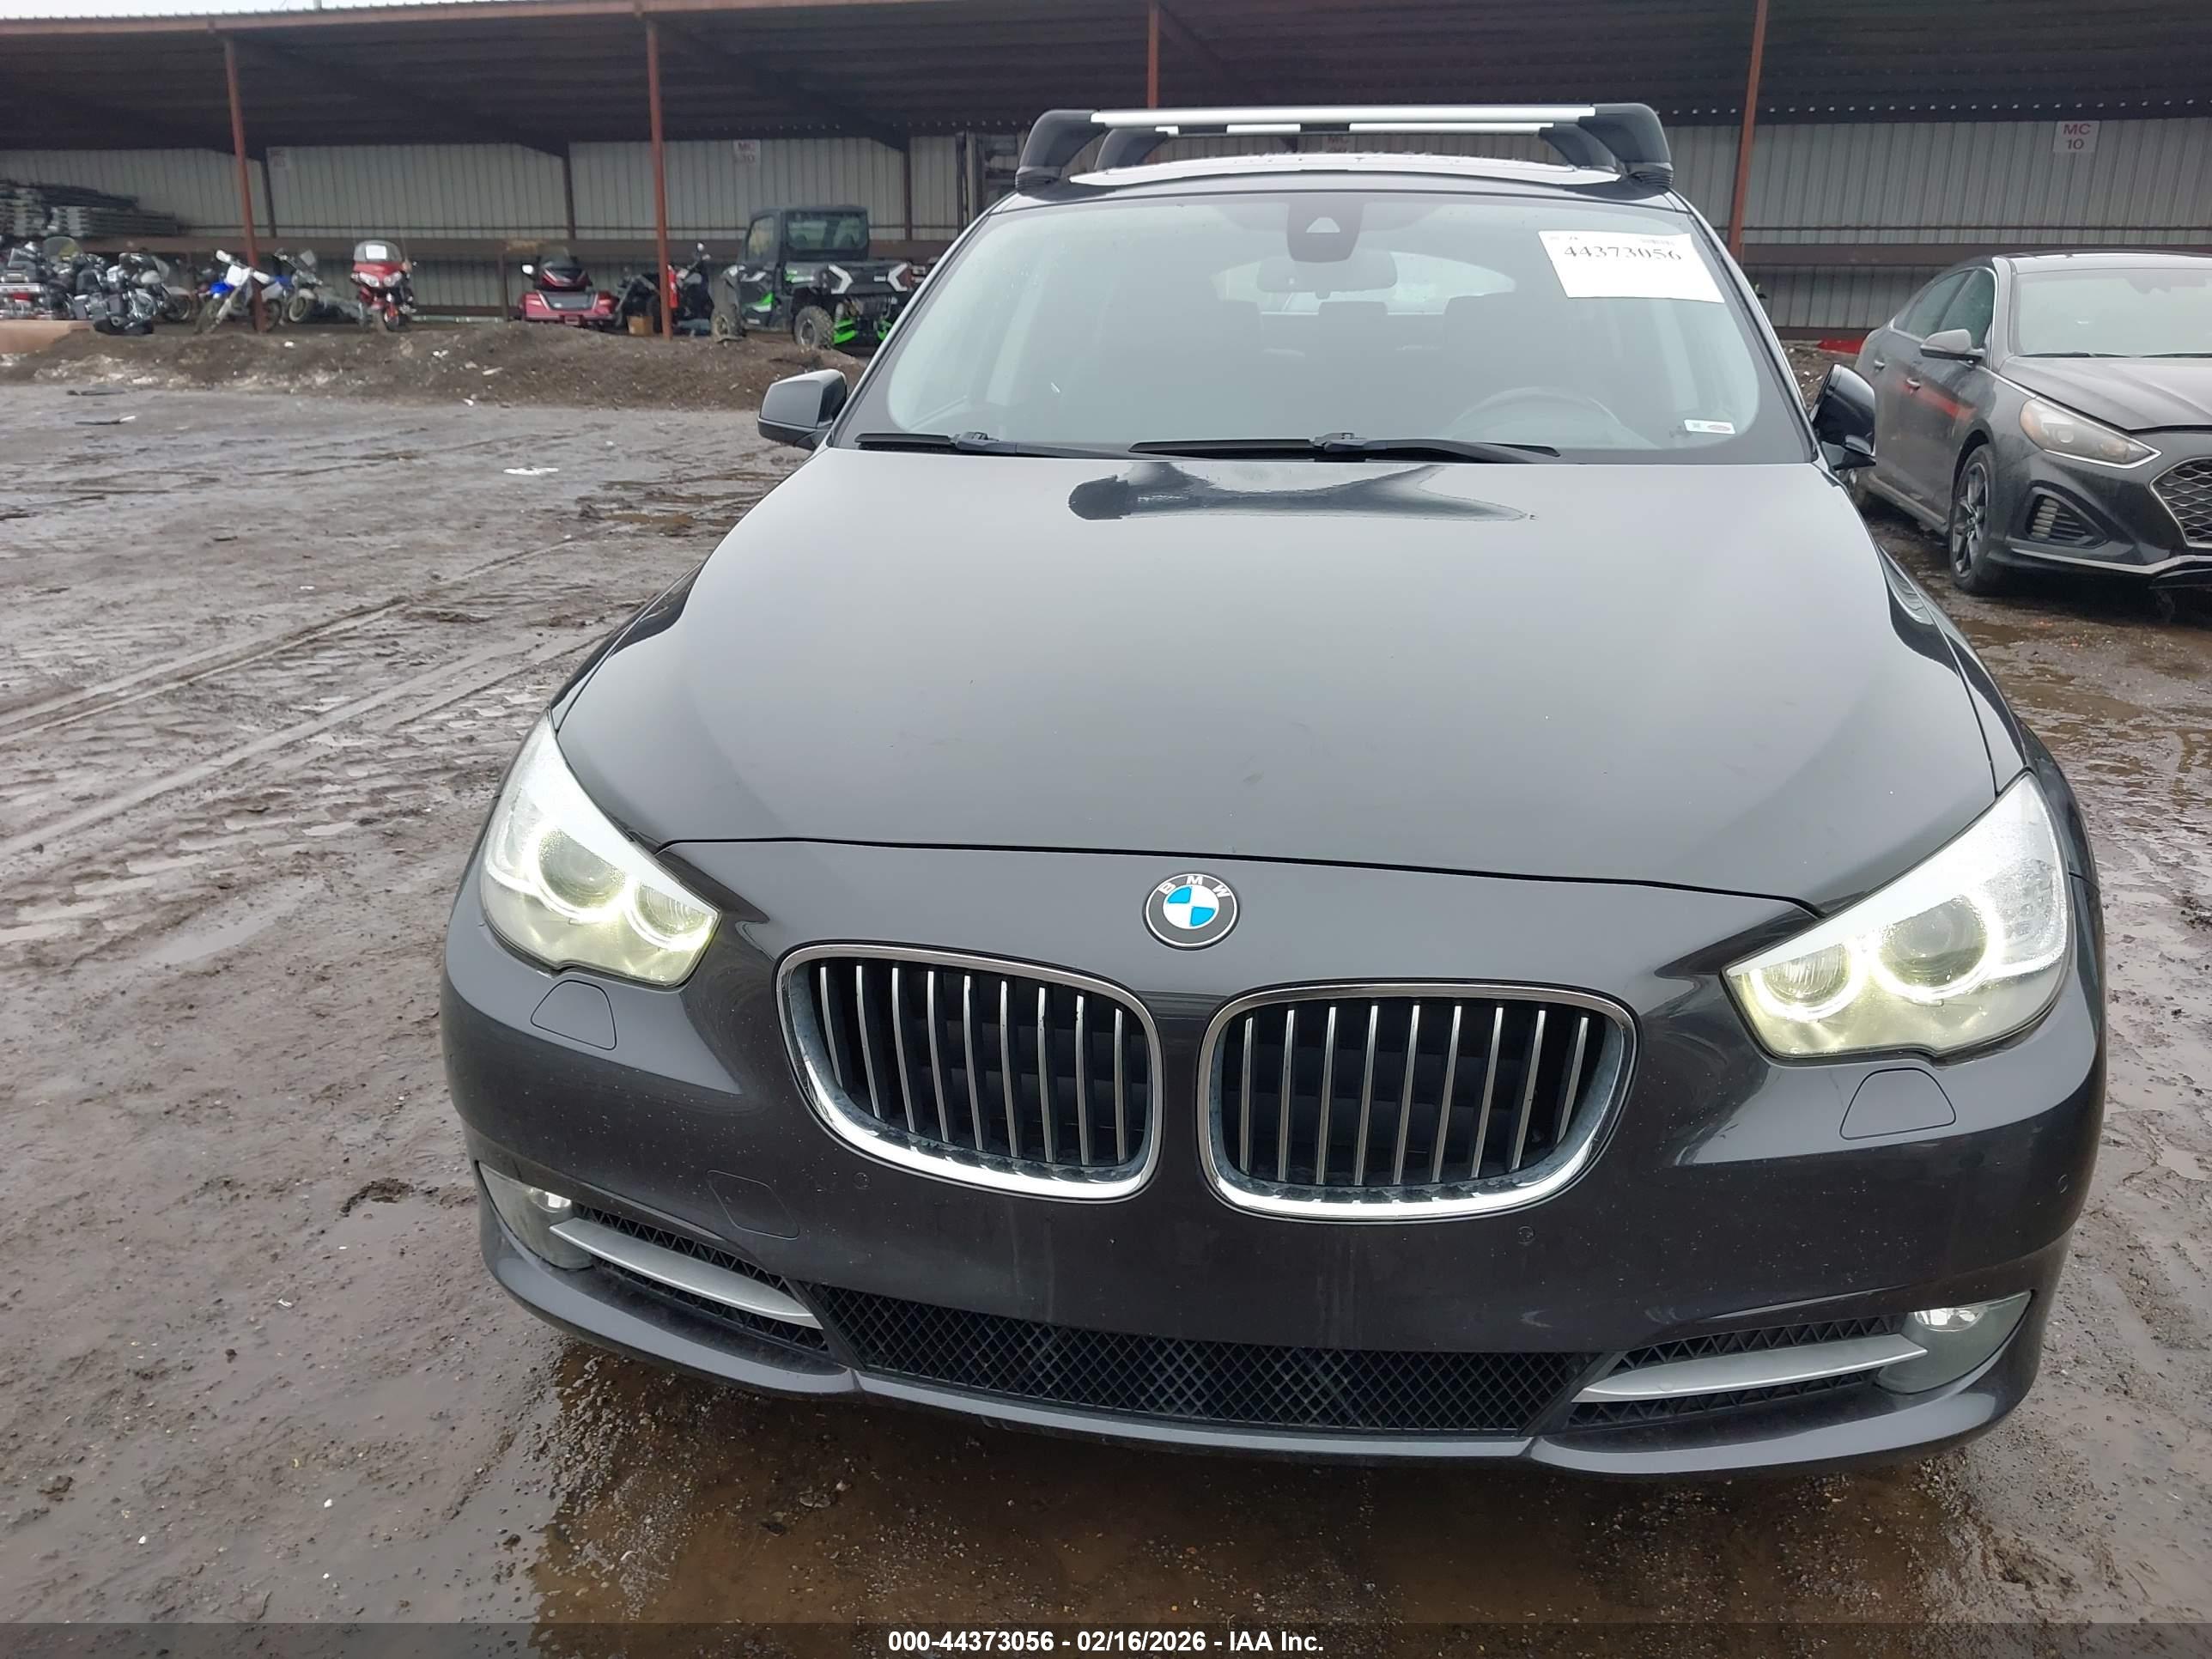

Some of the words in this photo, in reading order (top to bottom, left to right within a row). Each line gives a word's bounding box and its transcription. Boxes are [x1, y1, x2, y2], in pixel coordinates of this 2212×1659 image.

[2063, 123, 2091, 136] MC
[2067, 138, 2085, 149] 10
[1564, 246, 1682, 260] 44373056
[1158, 875, 1231, 898] BMW
